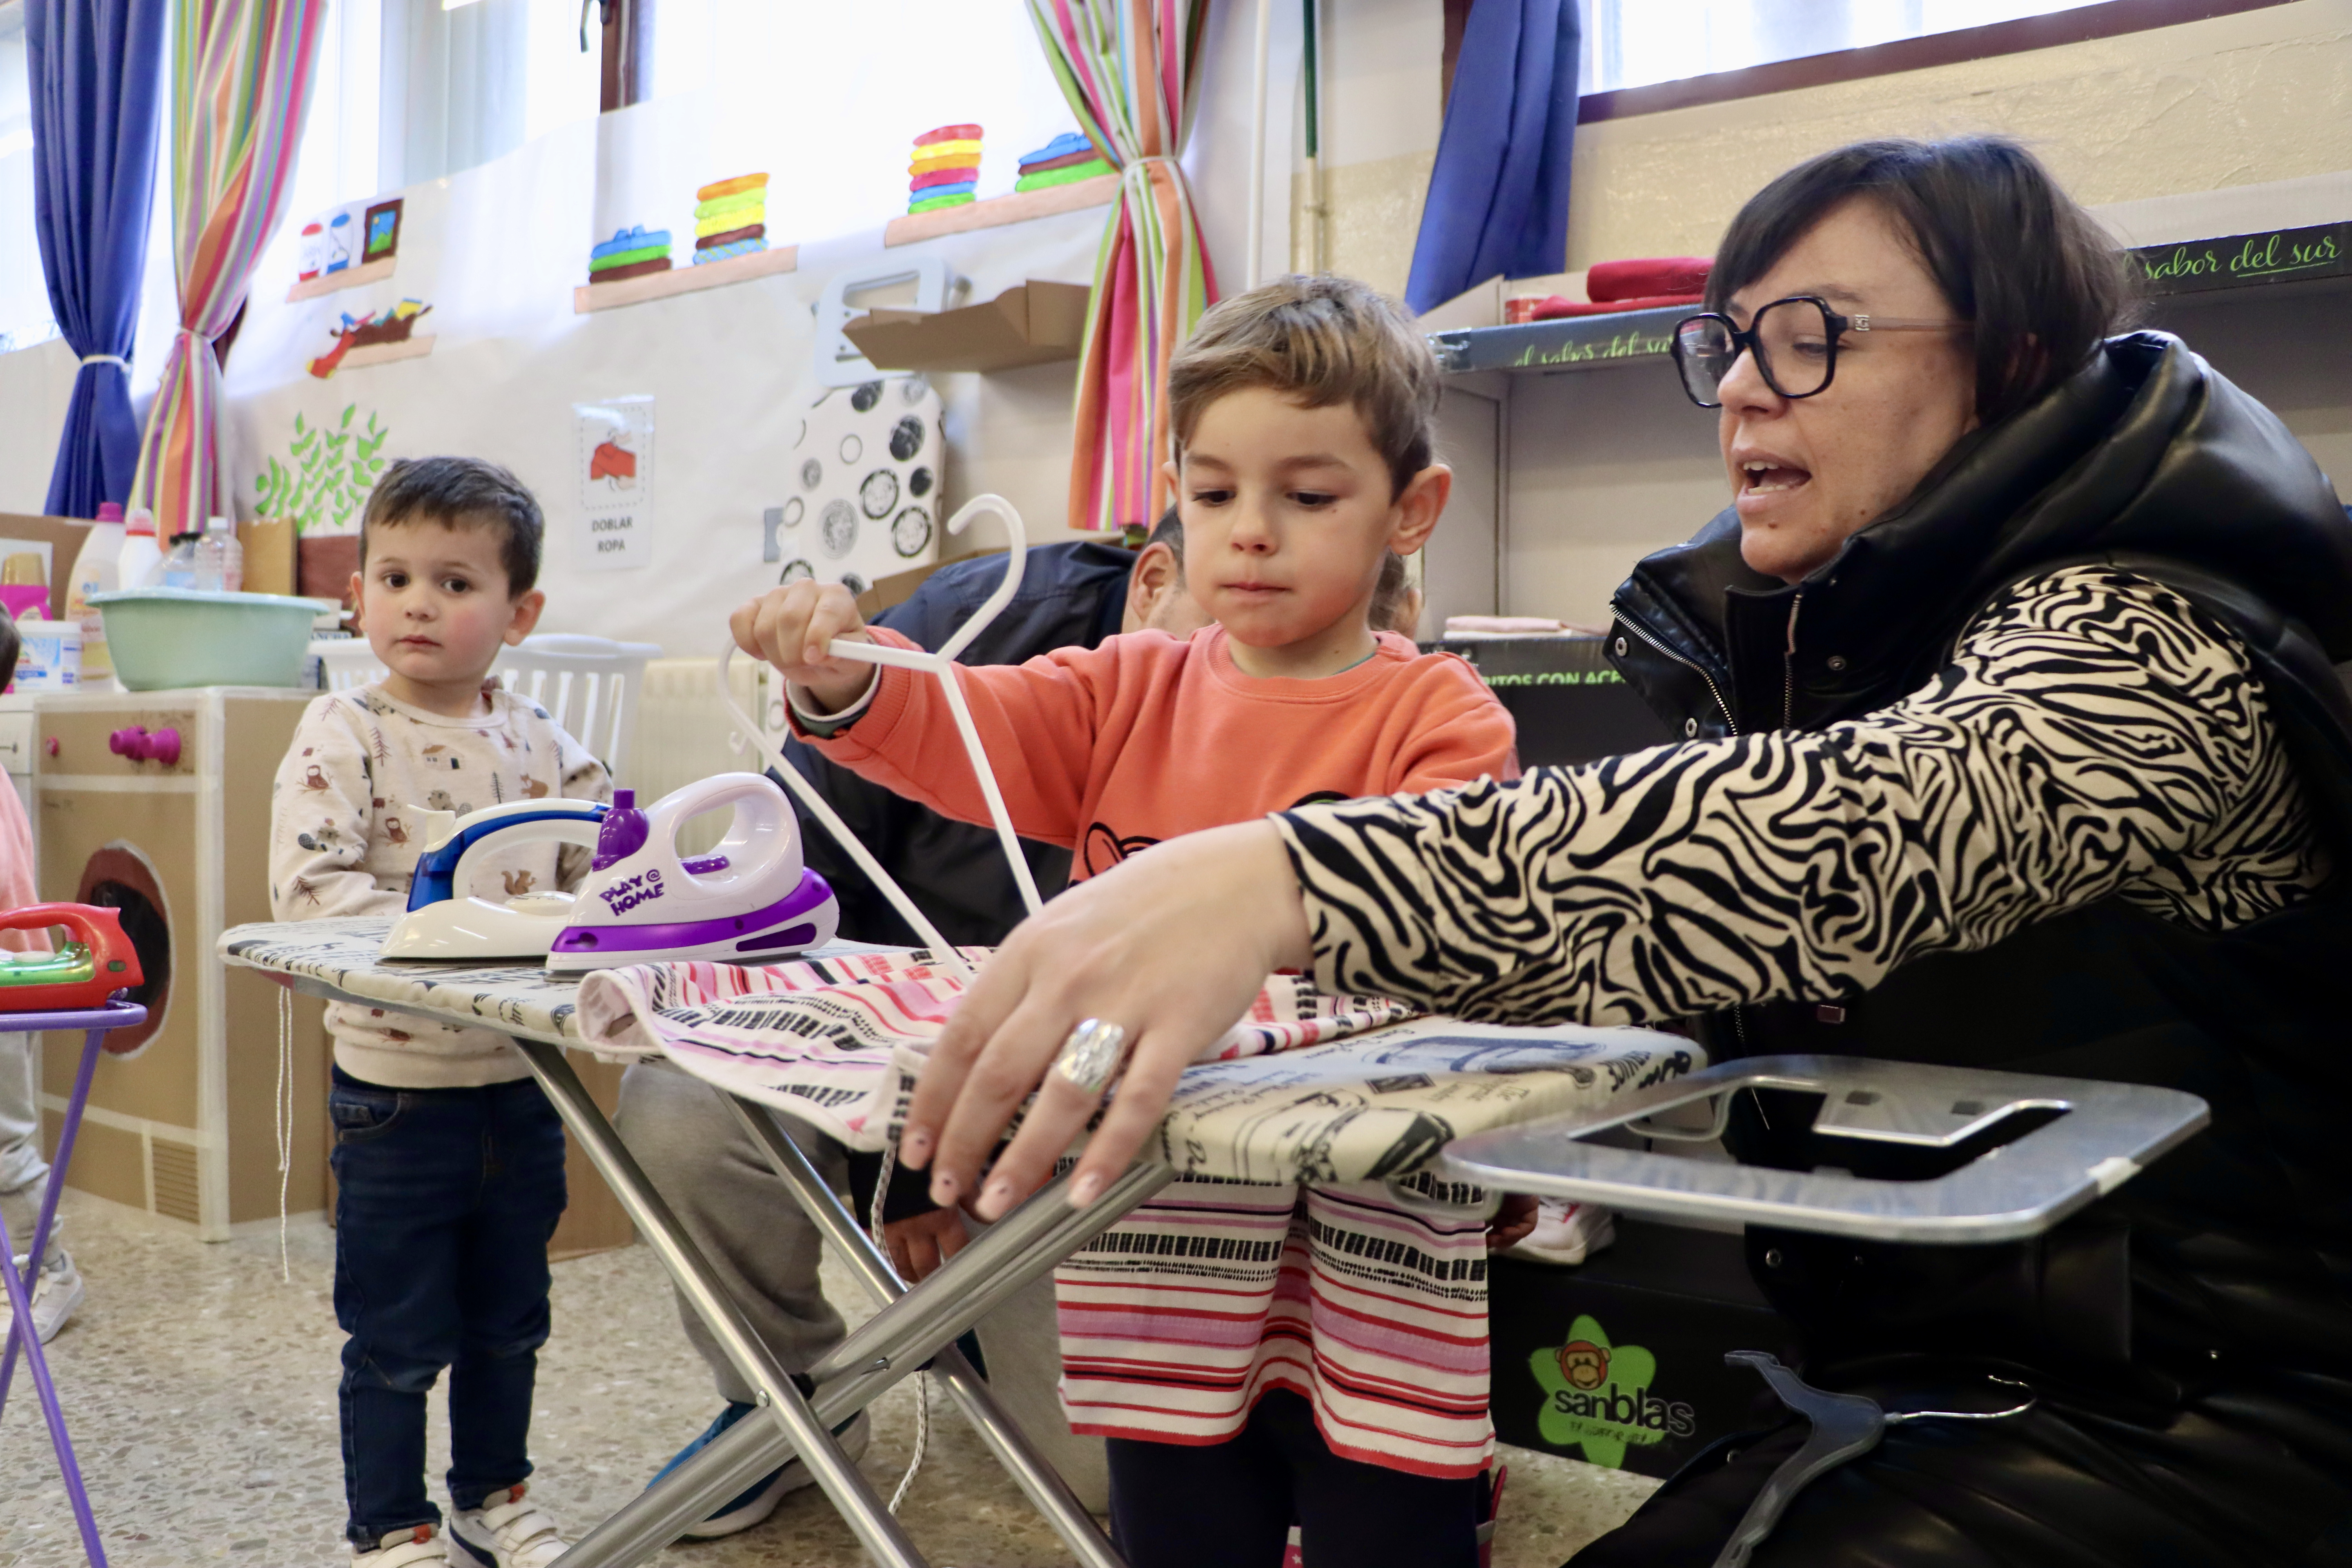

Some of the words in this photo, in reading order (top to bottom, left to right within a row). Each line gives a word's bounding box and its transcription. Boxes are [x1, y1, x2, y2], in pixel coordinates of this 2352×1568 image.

[2144, 247, 2222, 279] sabor
[2230, 234, 2281, 271] del
[2290, 236, 2342, 264] sur
[592, 516, 633, 532] DOBLAR
[598, 539, 626, 552] ROPA
[599, 875, 643, 902] PLAY
[646, 869, 661, 882] @
[610, 882, 664, 916] HOME
[1554, 1382, 1696, 1437] sanblas
